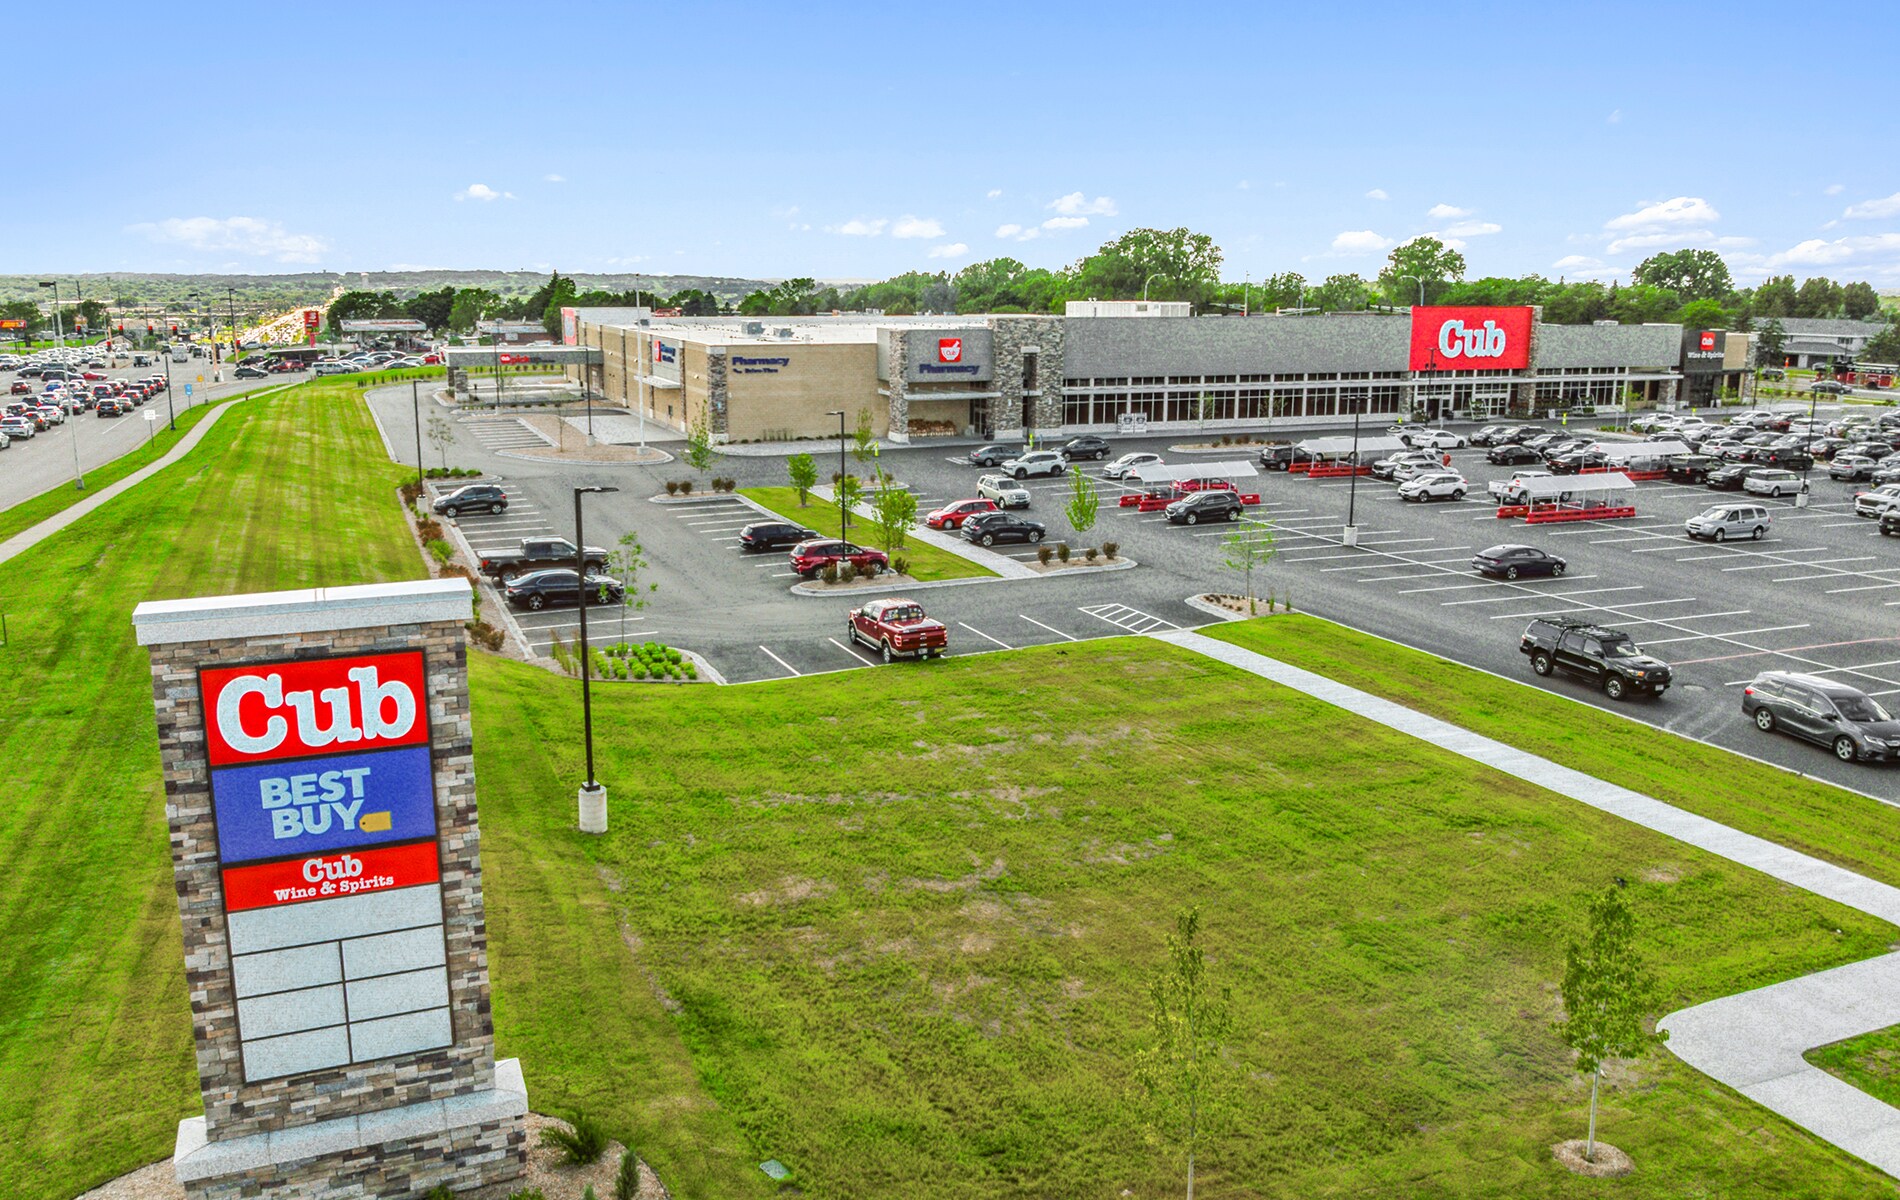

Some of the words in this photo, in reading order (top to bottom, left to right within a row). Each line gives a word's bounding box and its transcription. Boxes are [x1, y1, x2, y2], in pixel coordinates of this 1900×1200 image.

[1438, 319, 1506, 359] Cub
[1701, 337, 1714, 346] Cub
[732, 356, 790, 367] Pharmacy
[1687, 351, 1701, 359] Wine
[1707, 351, 1725, 360] Spirits
[919, 363, 981, 375] Pharmacy
[216, 665, 417, 754] Cub
[260, 767, 371, 809] BEST
[271, 799, 364, 839] BUY
[302, 855, 363, 882] Cub
[273, 887, 317, 901] Wine
[320, 881, 337, 895] &
[340, 875, 395, 893] Spirits
